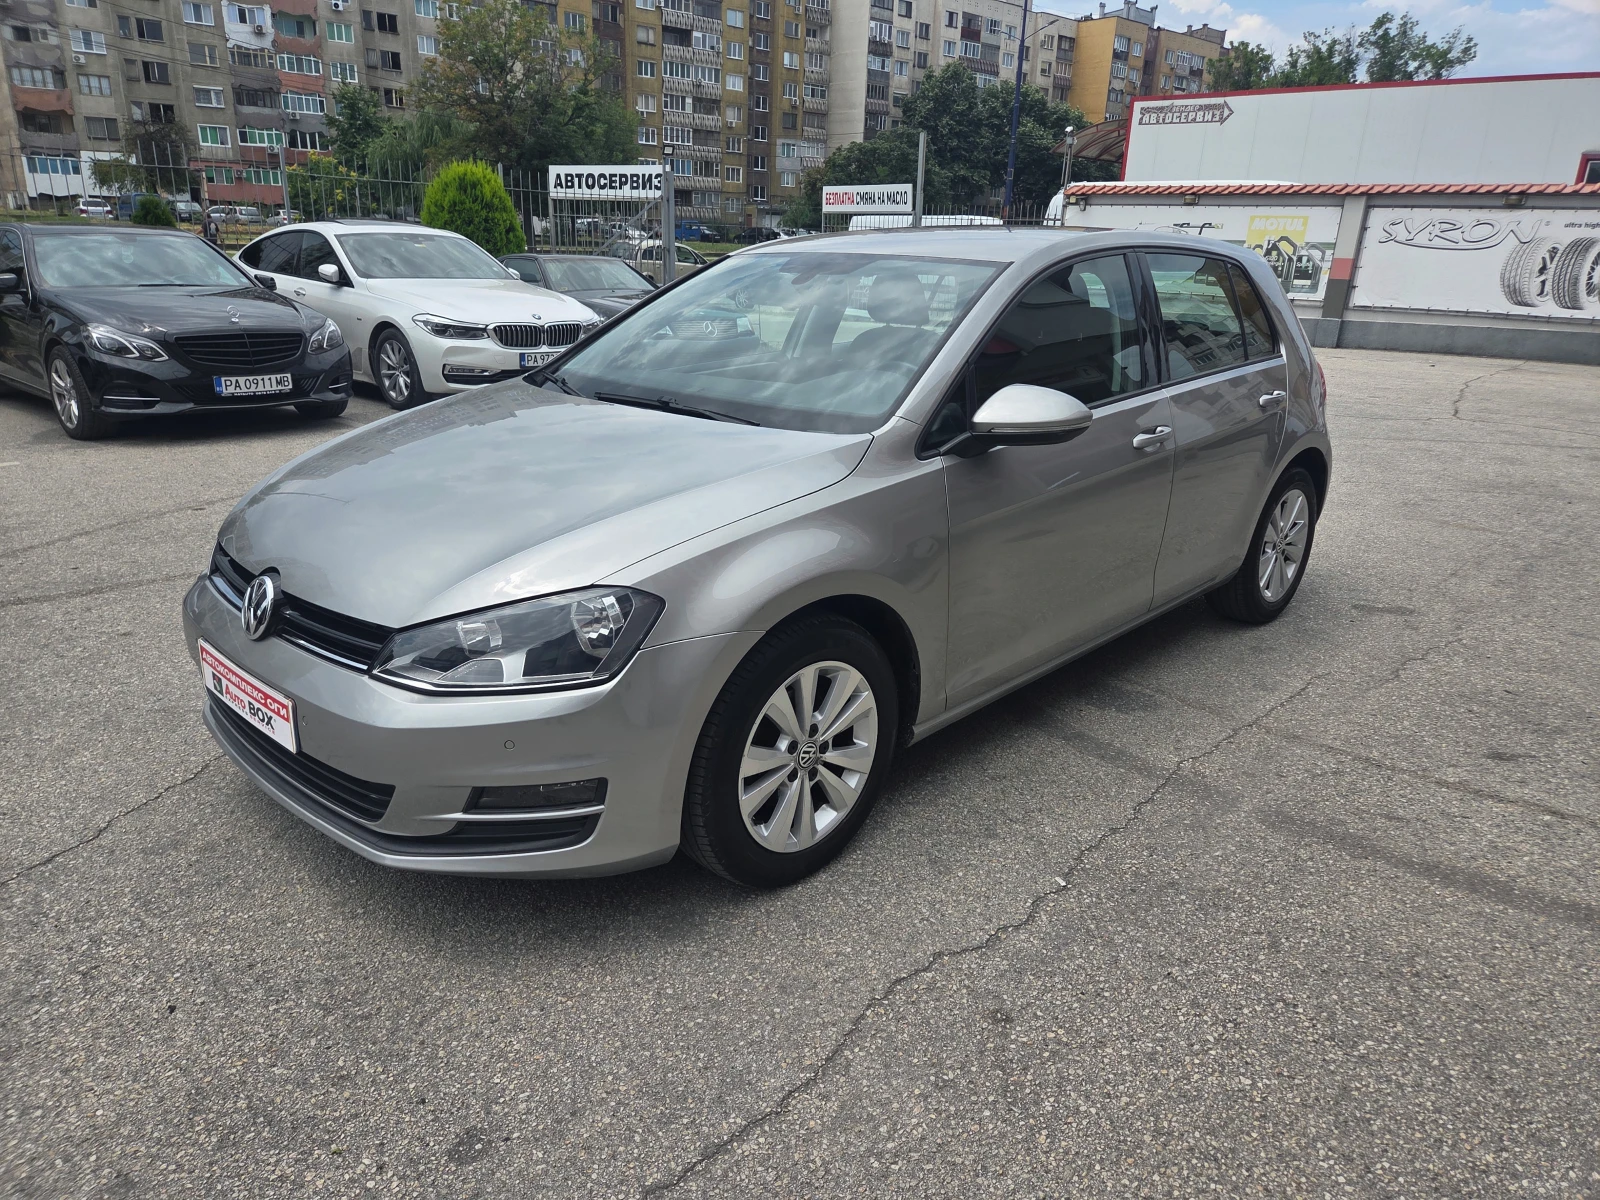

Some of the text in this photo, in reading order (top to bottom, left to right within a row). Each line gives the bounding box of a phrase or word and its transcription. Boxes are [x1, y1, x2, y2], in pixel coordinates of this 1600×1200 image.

[1141, 110, 1221, 125] АВТОСЕРВИЗ
[553, 173, 663, 191] АВТОСЕРВИЗ
[825, 190, 908, 206] БЕЗПЛАТНА СМЯНА НА МАСЛО
[1251, 217, 1305, 231] MOTUL
[1563, 221, 1583, 229] ultra
[1378, 218, 1543, 250] SYRON
[202, 651, 288, 719] АВТОКОМПЛЕКС ОГИ
[248, 699, 275, 731] BOX
